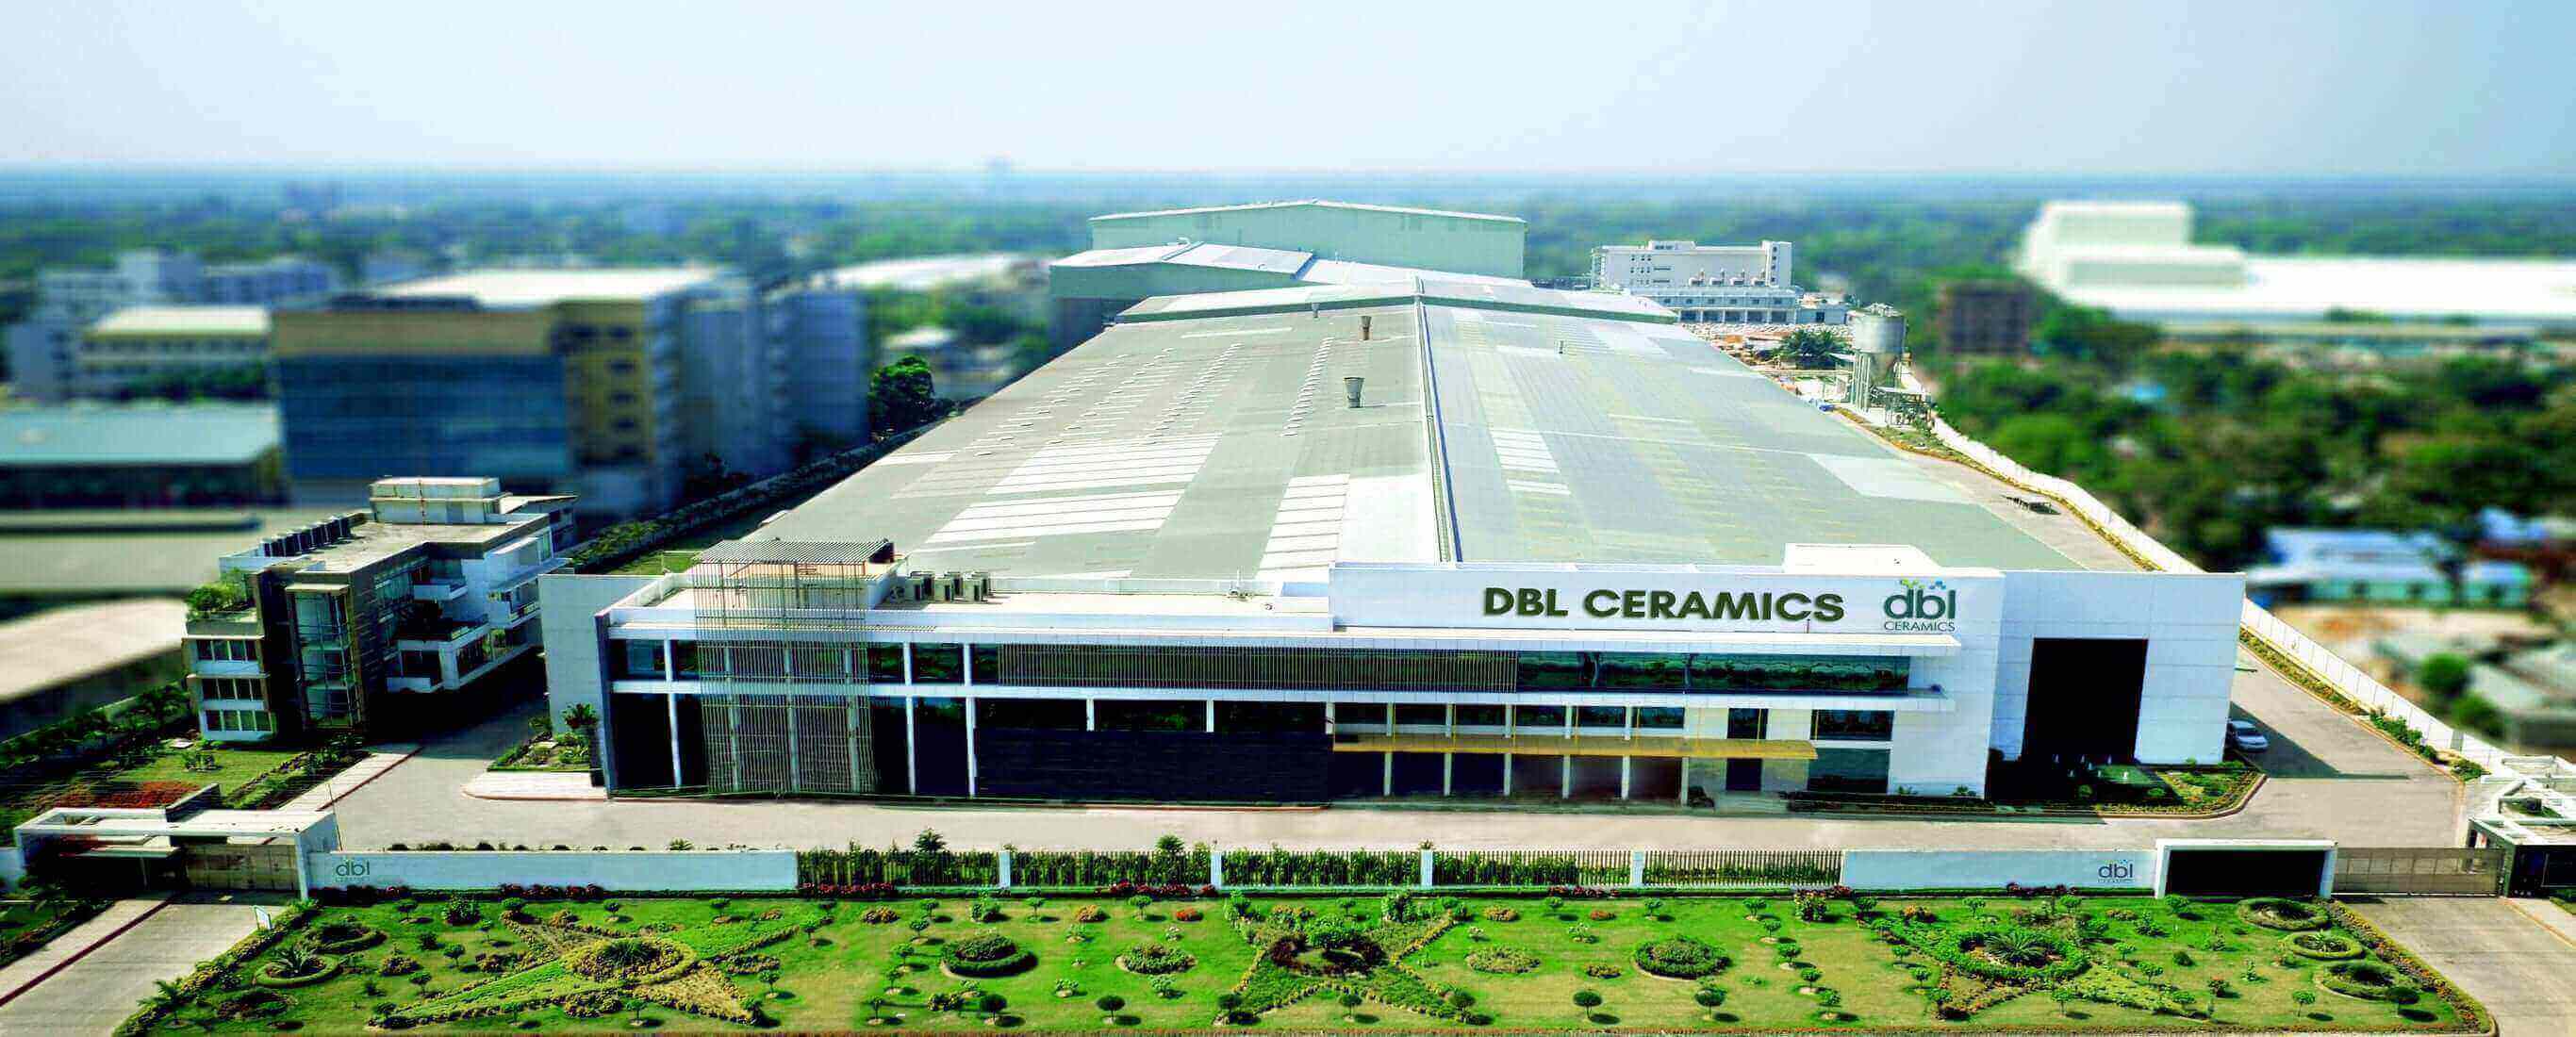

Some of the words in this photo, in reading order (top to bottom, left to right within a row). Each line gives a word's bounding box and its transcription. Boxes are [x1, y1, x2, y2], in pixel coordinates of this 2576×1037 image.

[1484, 587, 1568, 617] DBL
[1584, 588, 1845, 622] CERAMICS
[1884, 588, 1957, 619] dbl
[1884, 621, 1956, 632] CERAMICS
[336, 860, 371, 876] dbl
[2098, 863, 2134, 879] dbl
